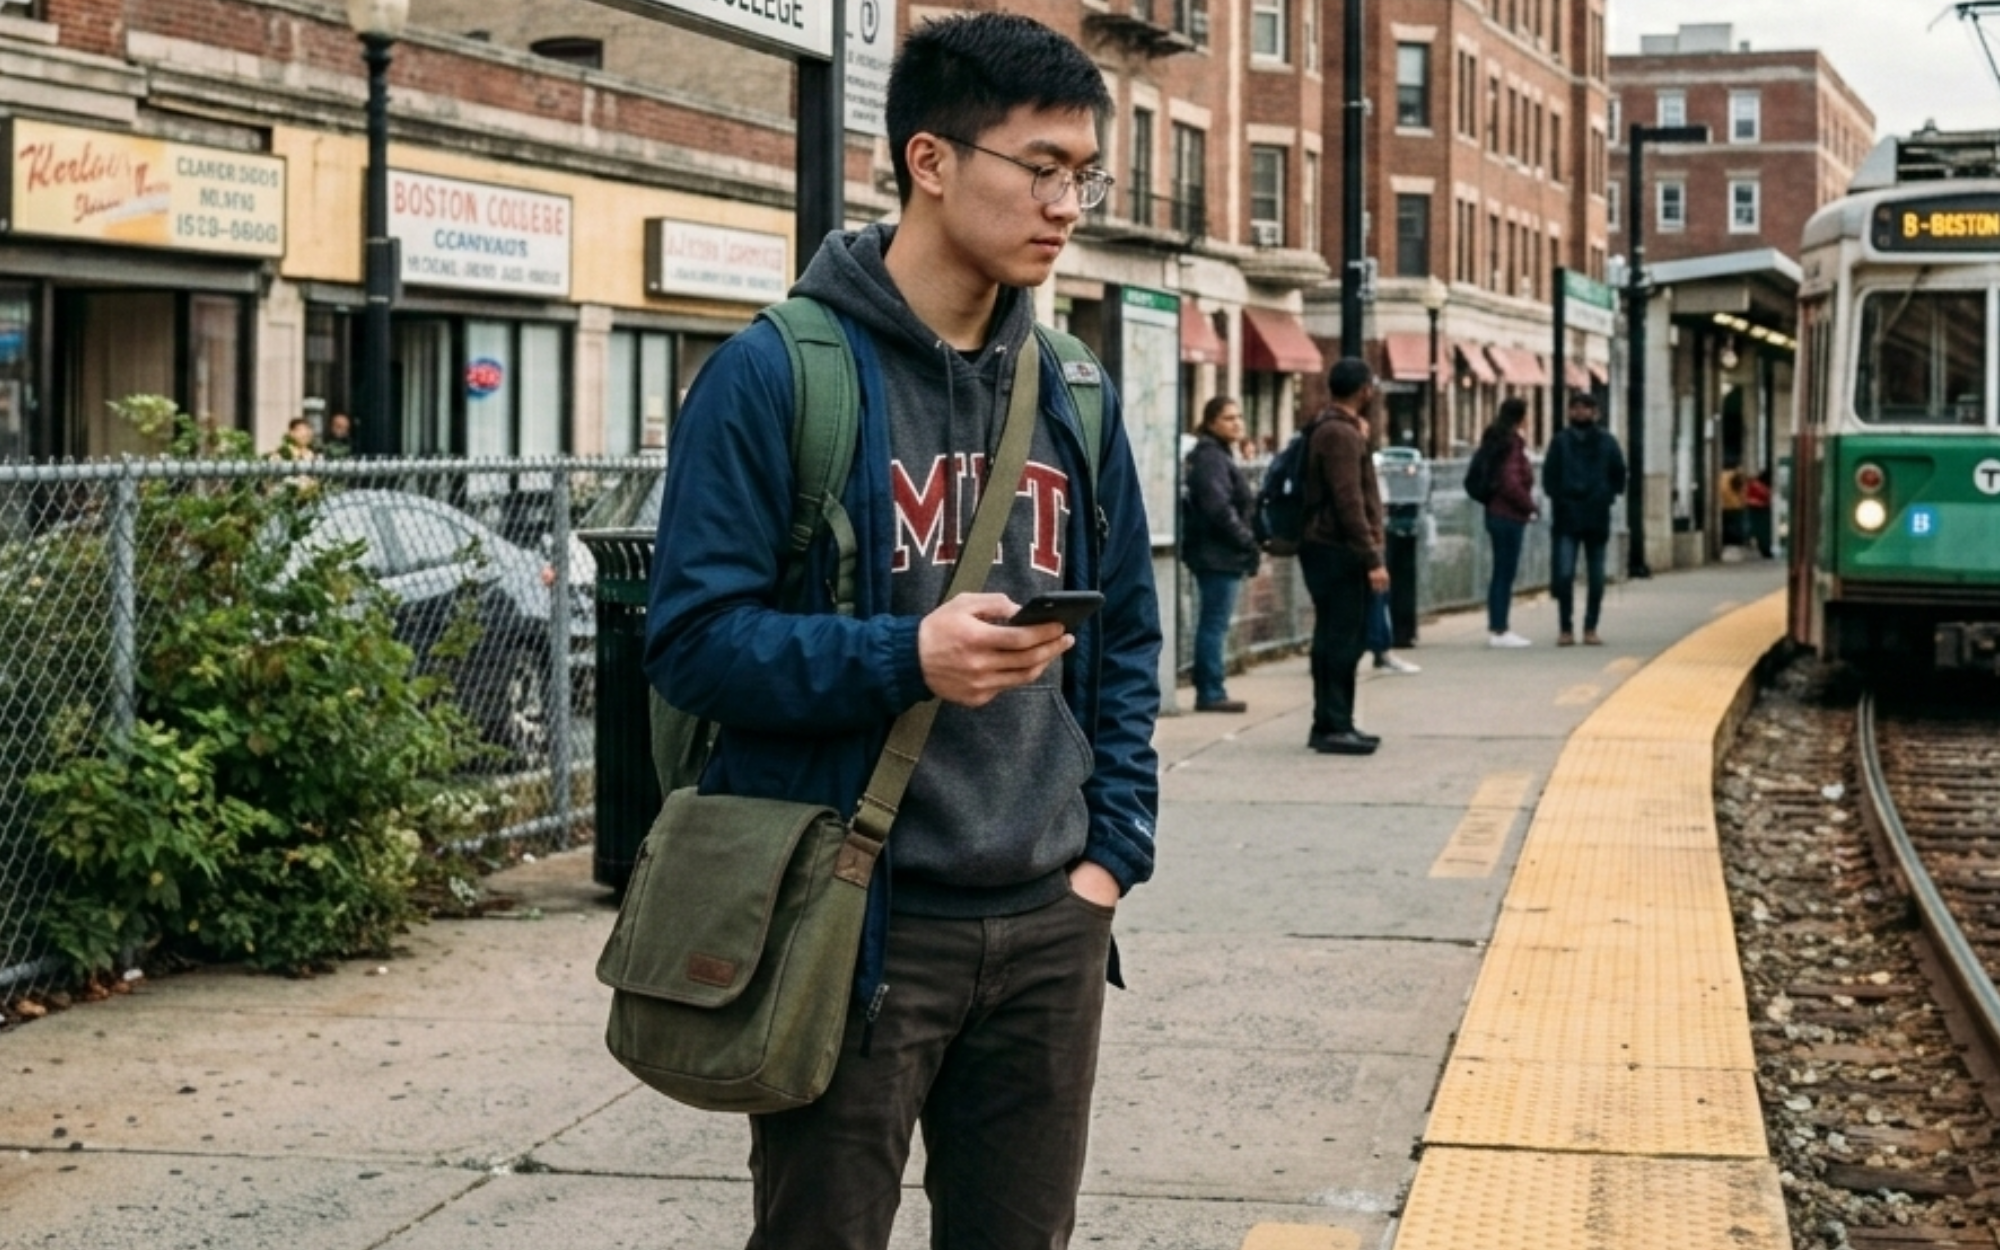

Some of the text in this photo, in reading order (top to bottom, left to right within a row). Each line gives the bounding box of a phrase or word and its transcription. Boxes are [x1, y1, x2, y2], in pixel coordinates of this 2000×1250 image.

[711, 0, 804, 30] LEGE
[394, 180, 478, 224] BOSTON
[1980, 467, 2000, 489] T
[891, 452, 1070, 577] MT
[1913, 513, 1930, 533] B
